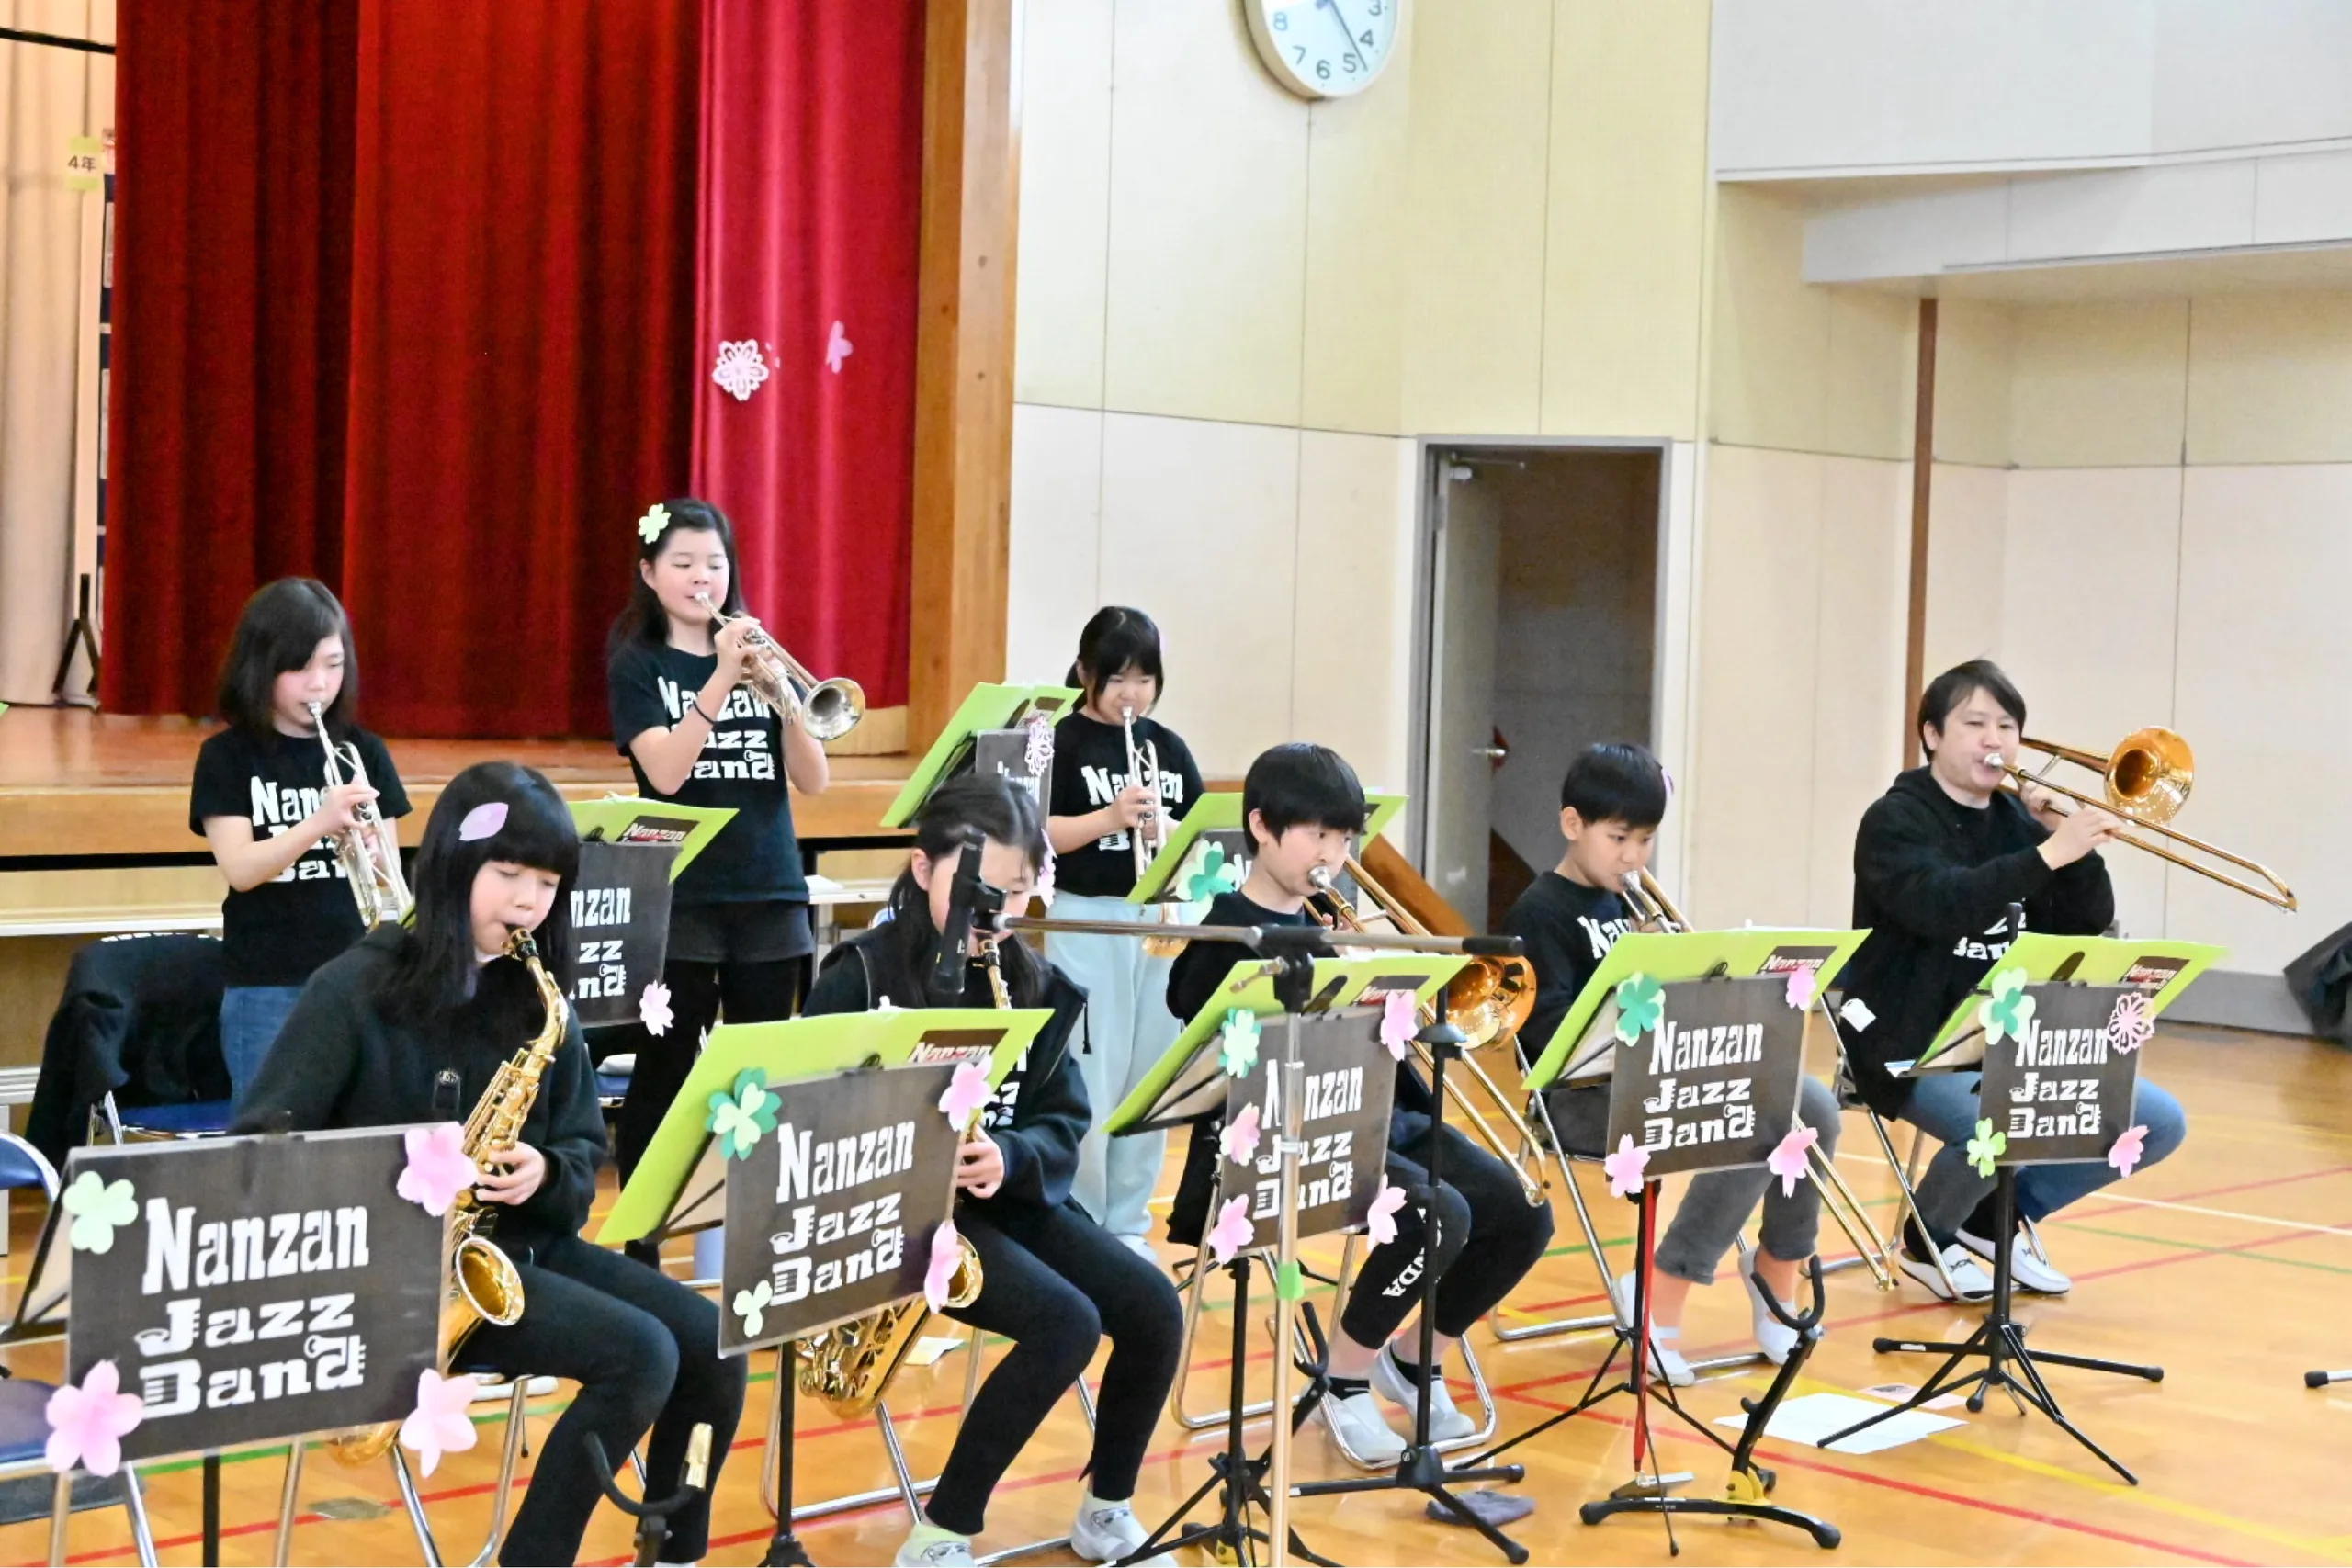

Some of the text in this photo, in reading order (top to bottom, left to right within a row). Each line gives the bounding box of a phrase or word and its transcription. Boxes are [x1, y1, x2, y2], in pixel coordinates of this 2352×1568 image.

[1272, 12, 1288, 31] 8
[1359, 29, 1374, 48] 4
[1293, 45, 1306, 65] 7
[1316, 60, 1331, 80] 6
[1342, 53, 1356, 73] 5
[67, 154, 96, 173] 4年
[657, 675, 771, 722] Nazan
[688, 750, 775, 780] and
[570, 887, 631, 928] nzan
[578, 940, 624, 964] zz
[577, 963, 627, 999] nd
[1648, 1018, 1763, 1075] Nanzan
[2015, 1019, 2109, 1066] Nanzan
[1261, 1059, 1363, 1130] Nnzan
[1644, 1077, 1752, 1114] Jazz
[2009, 1072, 2100, 1103] Jazz
[1643, 1103, 1756, 1151] Band
[2007, 1101, 2102, 1139] Band
[775, 1121, 915, 1204] Nanzan
[769, 1192, 902, 1255] Jazz
[141, 1197, 369, 1294] Nanzan
[770, 1224, 905, 1306] Band
[134, 1293, 356, 1358] Jazz
[141, 1334, 367, 1420] Band
